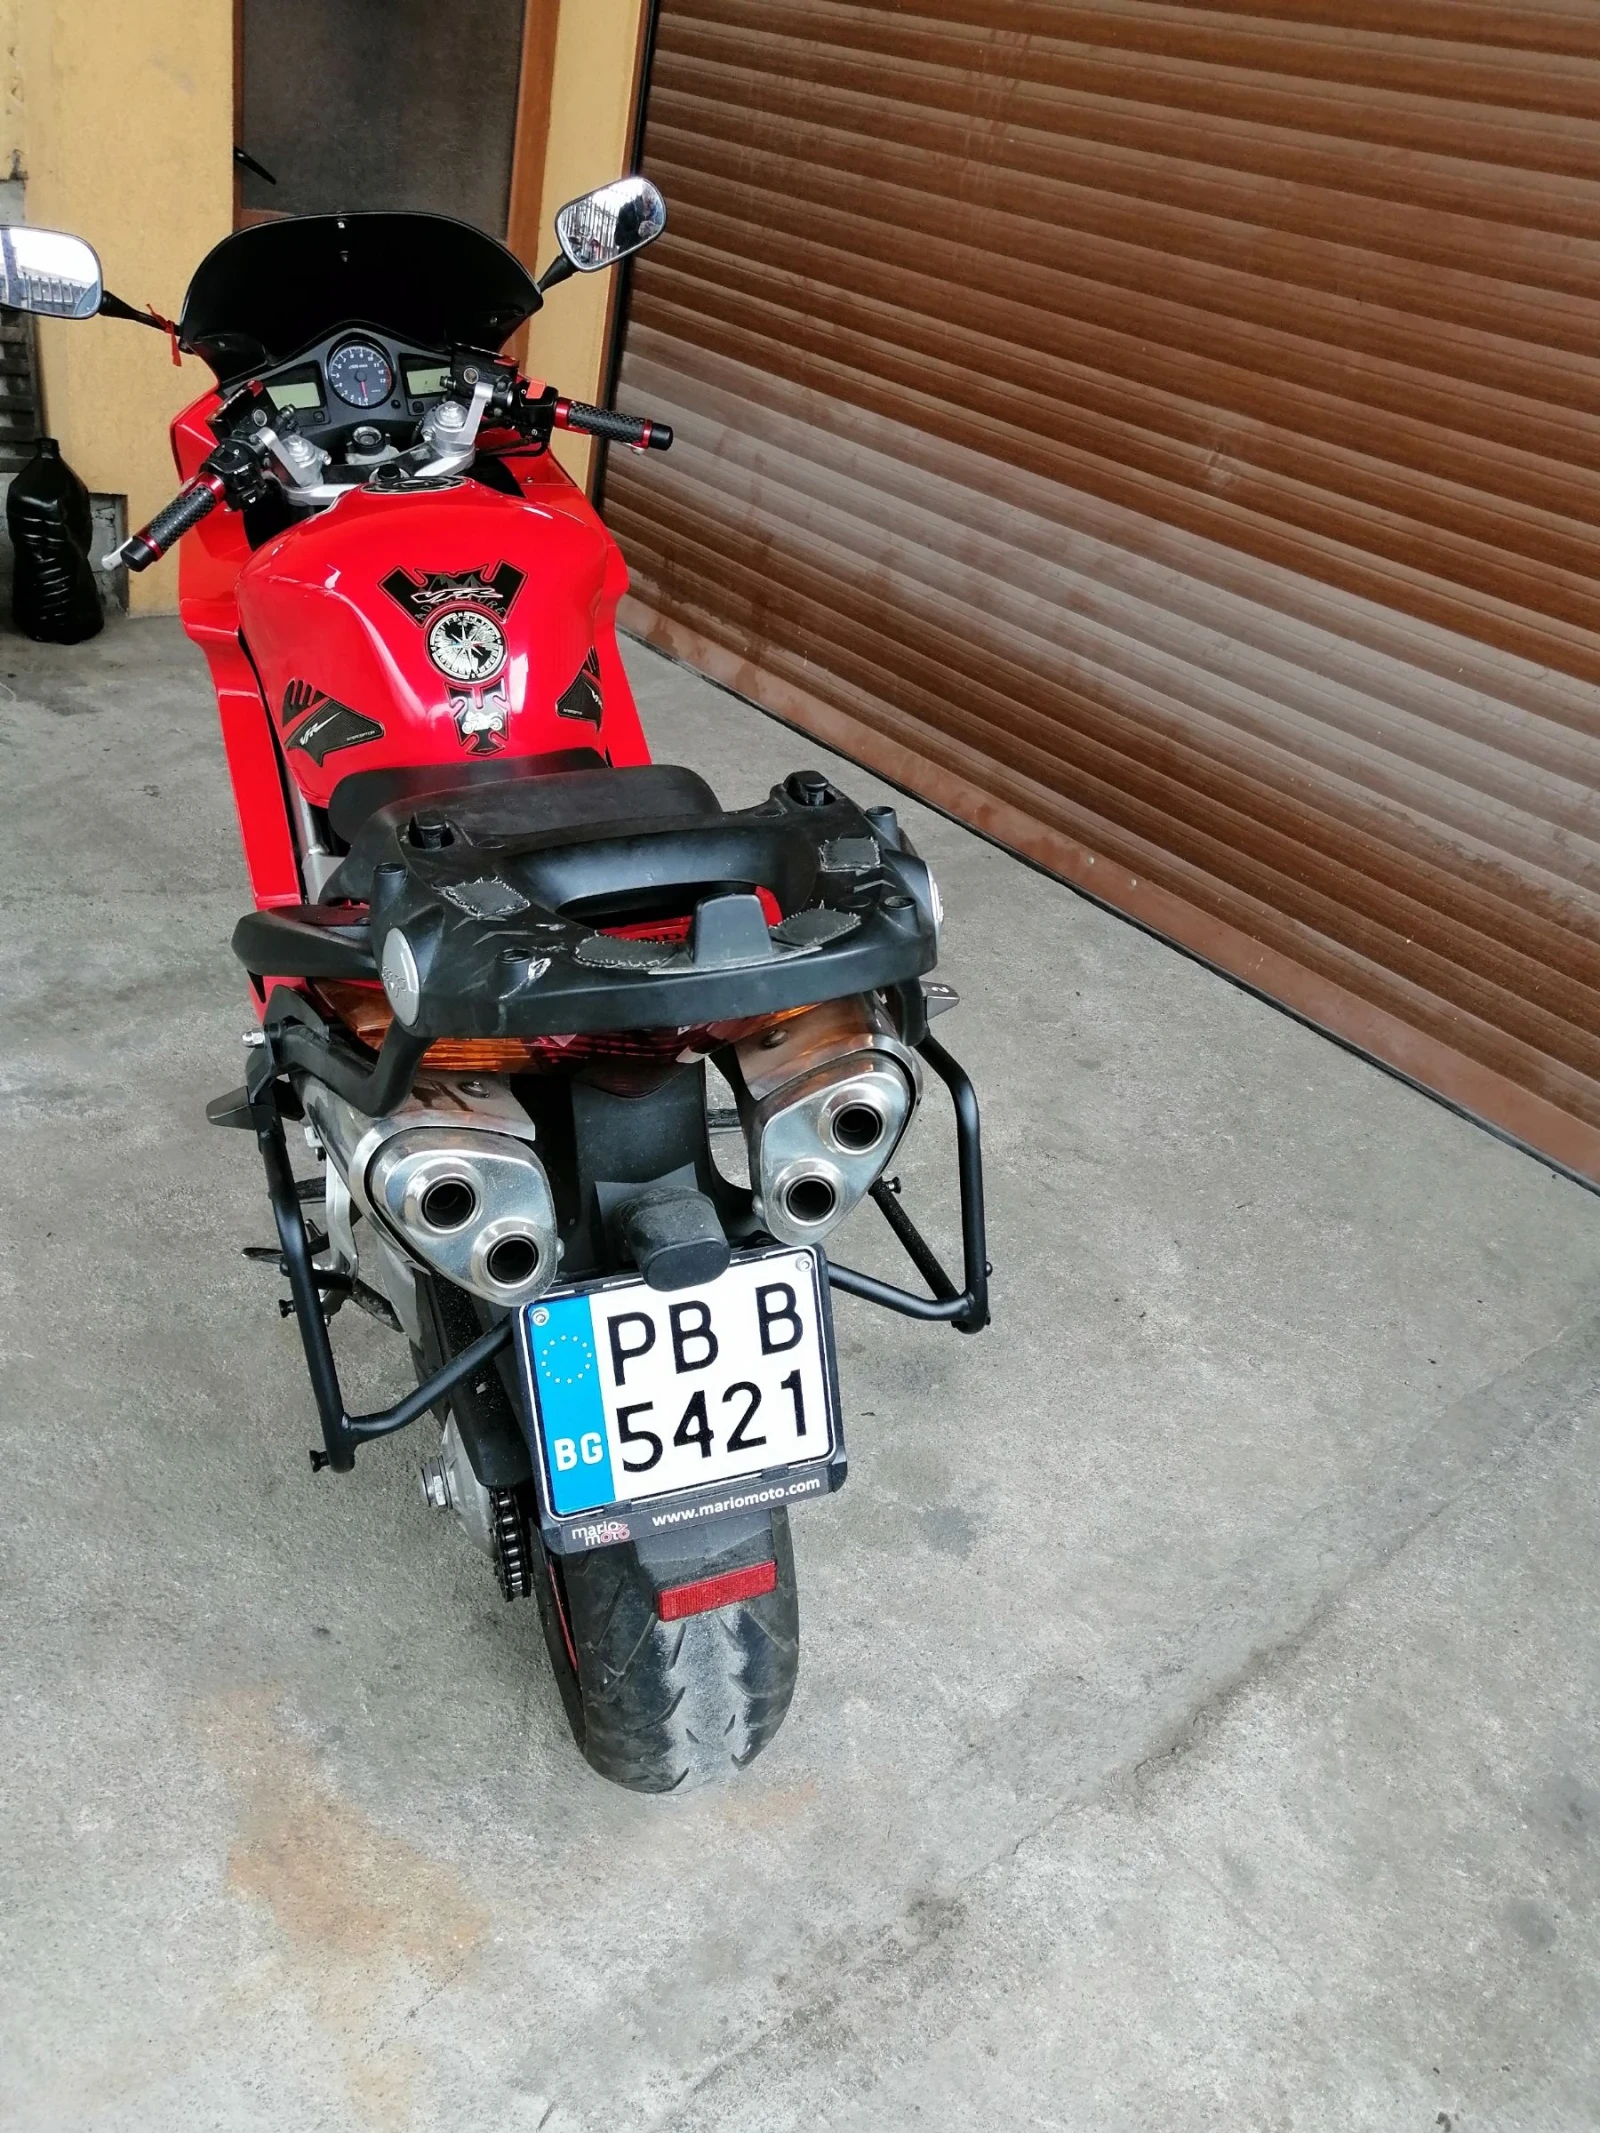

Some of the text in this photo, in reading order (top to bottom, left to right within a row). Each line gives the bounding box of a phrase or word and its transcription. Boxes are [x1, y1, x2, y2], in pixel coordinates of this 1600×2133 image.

[606, 1282, 804, 1387] PB B
[615, 1369, 807, 1473] 5421
[553, 1432, 604, 1472] BG
[651, 1477, 821, 1527] www.mariomoto.com
[571, 1520, 620, 1540] mario
